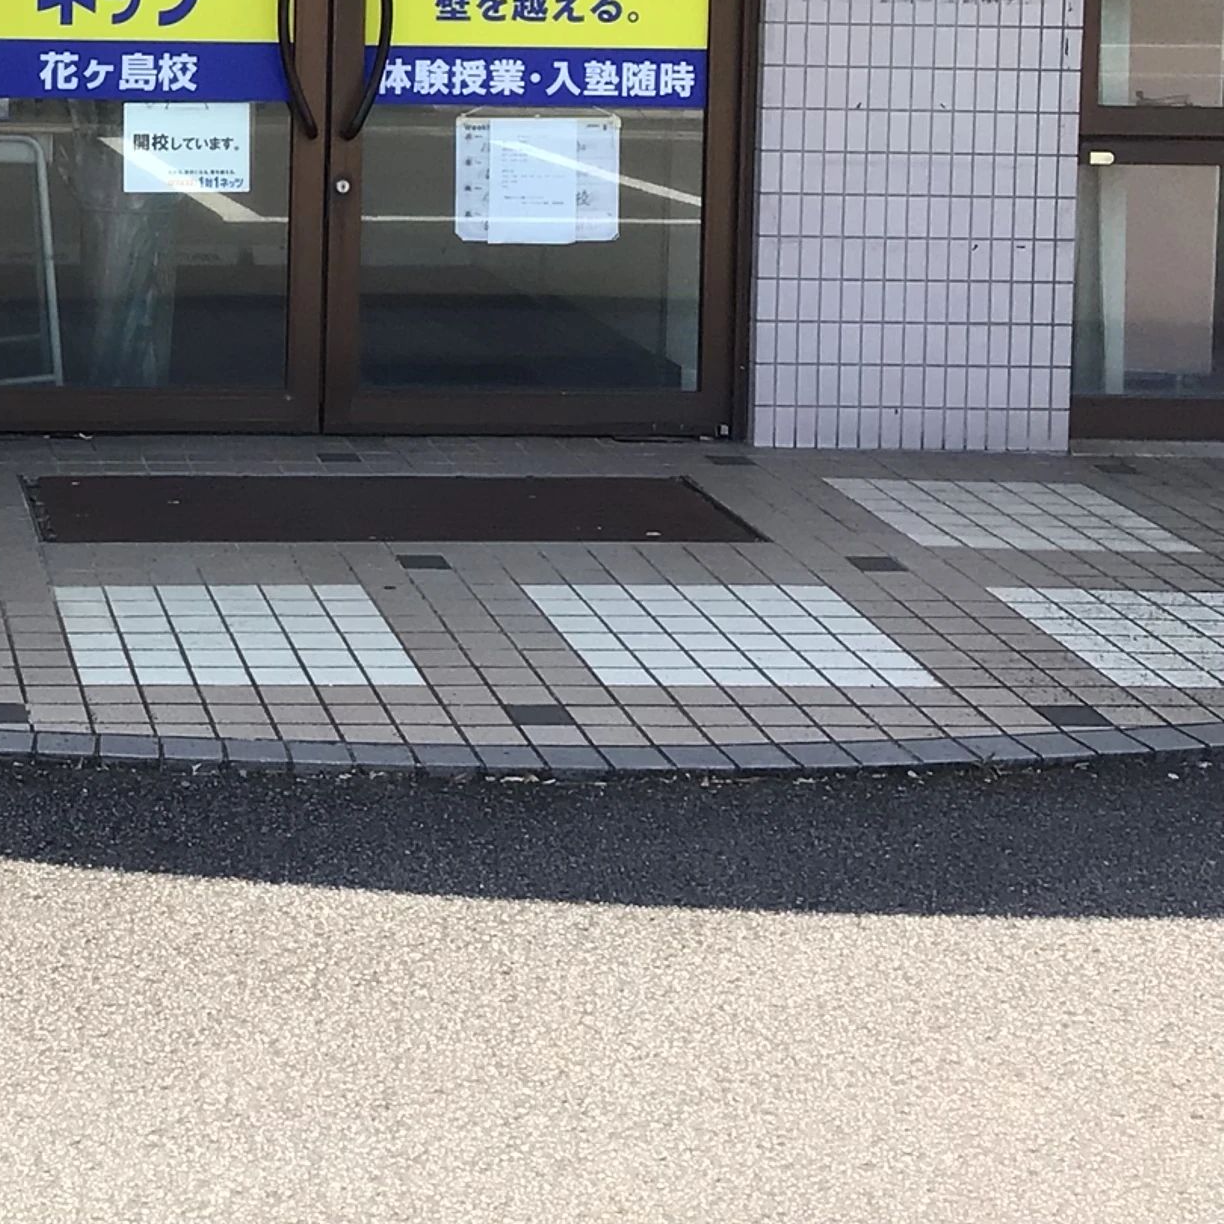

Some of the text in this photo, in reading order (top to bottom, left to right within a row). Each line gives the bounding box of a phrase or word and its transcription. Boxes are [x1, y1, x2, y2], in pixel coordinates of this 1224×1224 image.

[39, 51, 198, 92] 花ヶ島校
[133, 133, 239, 151] 開校しています。
